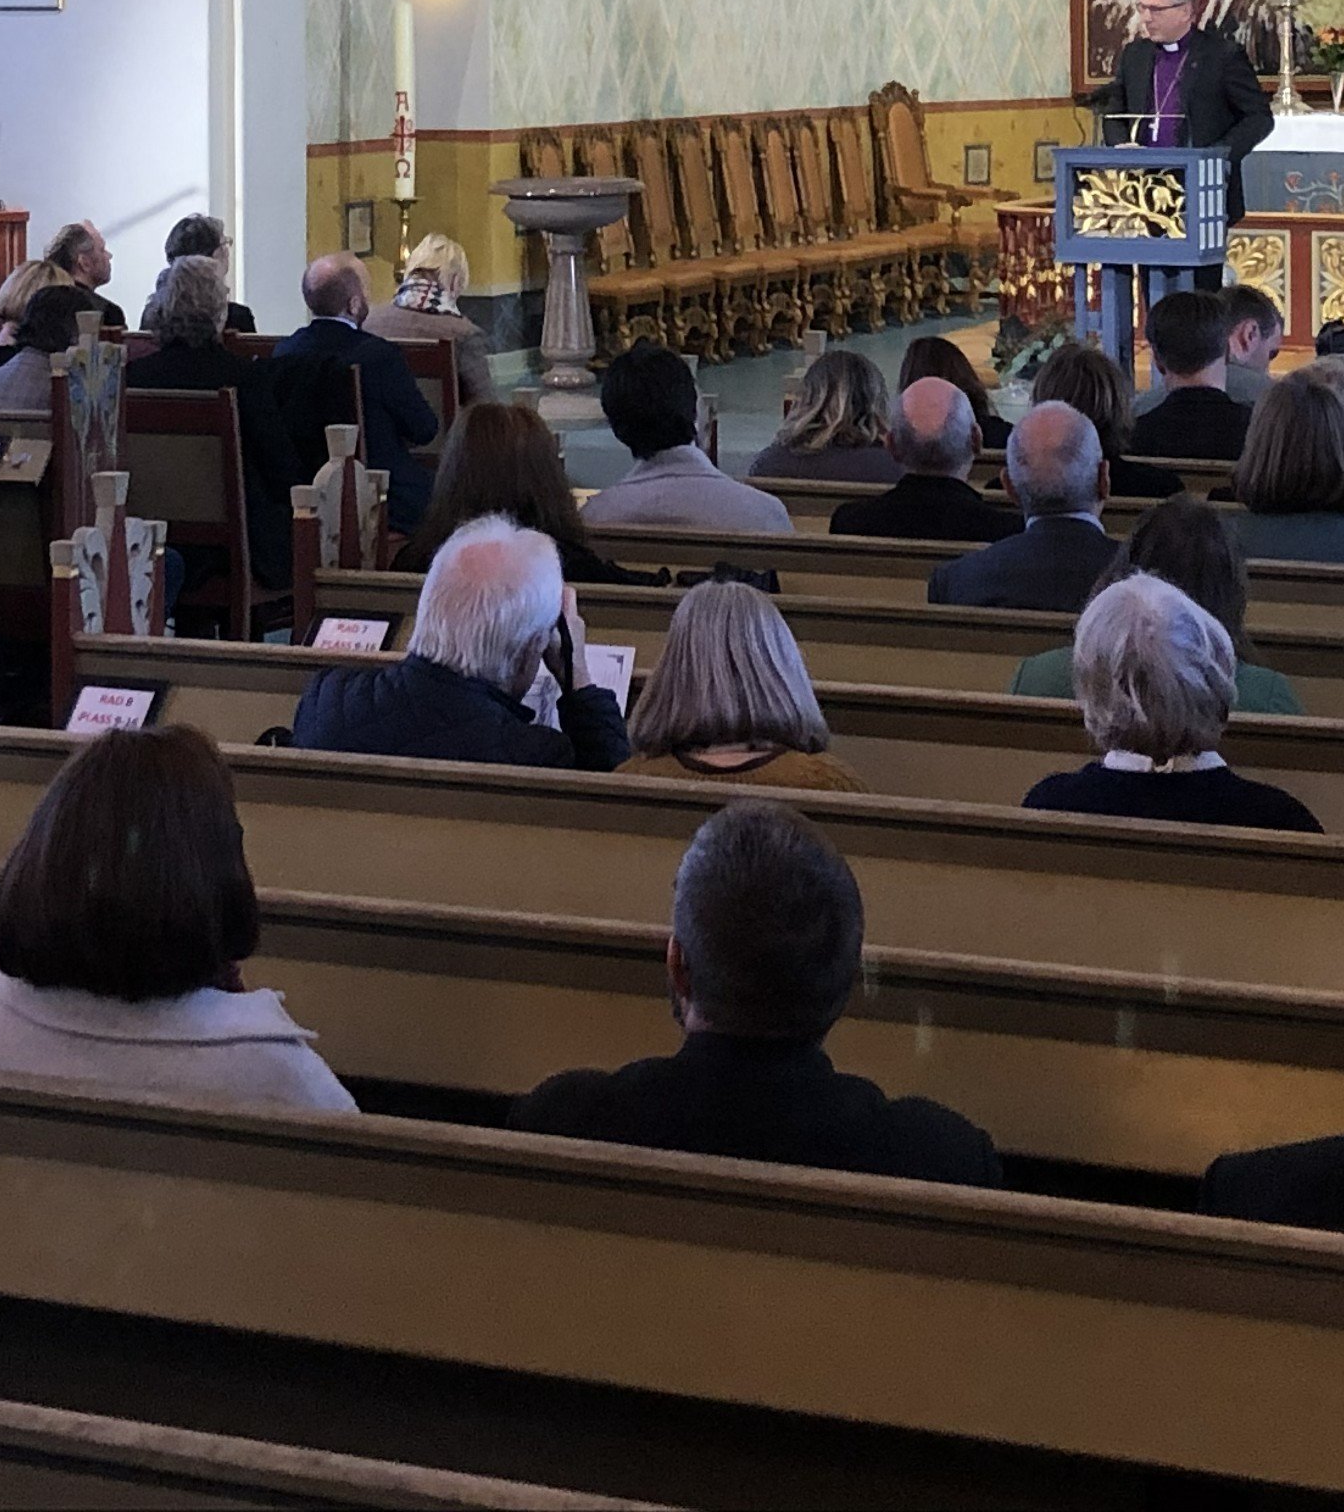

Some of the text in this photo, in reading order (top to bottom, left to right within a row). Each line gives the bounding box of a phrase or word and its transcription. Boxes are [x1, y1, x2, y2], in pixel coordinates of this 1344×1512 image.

[395, 157, 411, 179] Ω
[99, 694, 124, 705] RAD
[77, 711, 112, 724] PLASS
